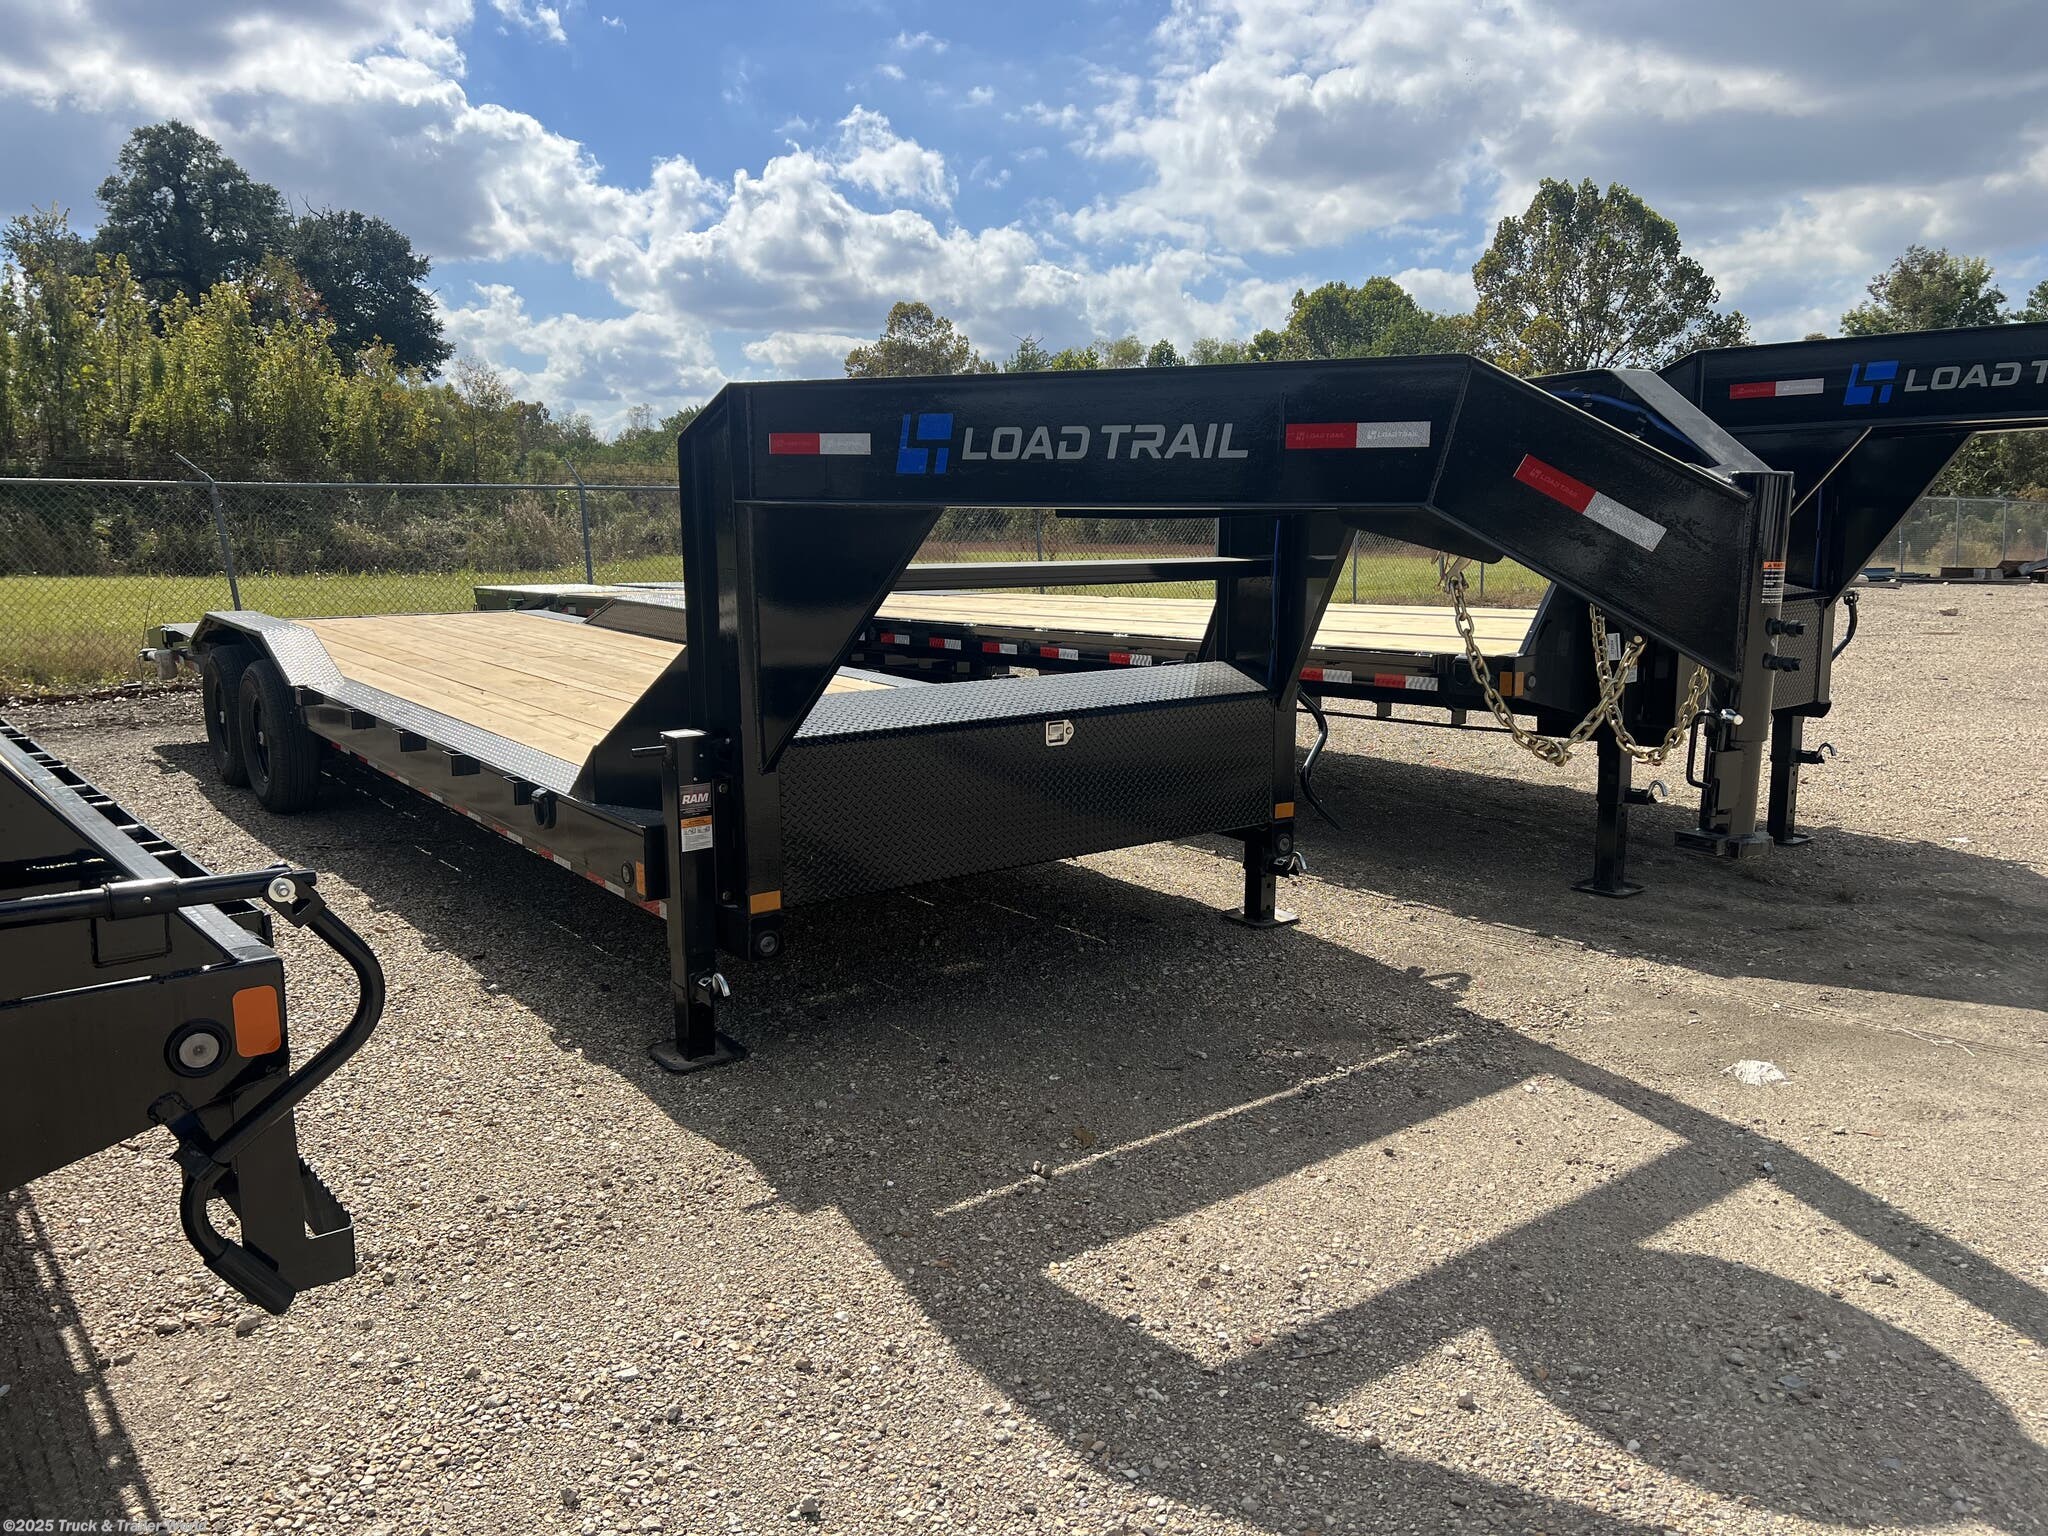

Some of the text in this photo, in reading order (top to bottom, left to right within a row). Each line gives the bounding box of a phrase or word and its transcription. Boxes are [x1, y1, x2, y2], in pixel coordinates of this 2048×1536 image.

[1903, 362, 2022, 392] LOAD
[961, 423, 1249, 460] LOAD TRAIL
[681, 792, 709, 805] RAM
